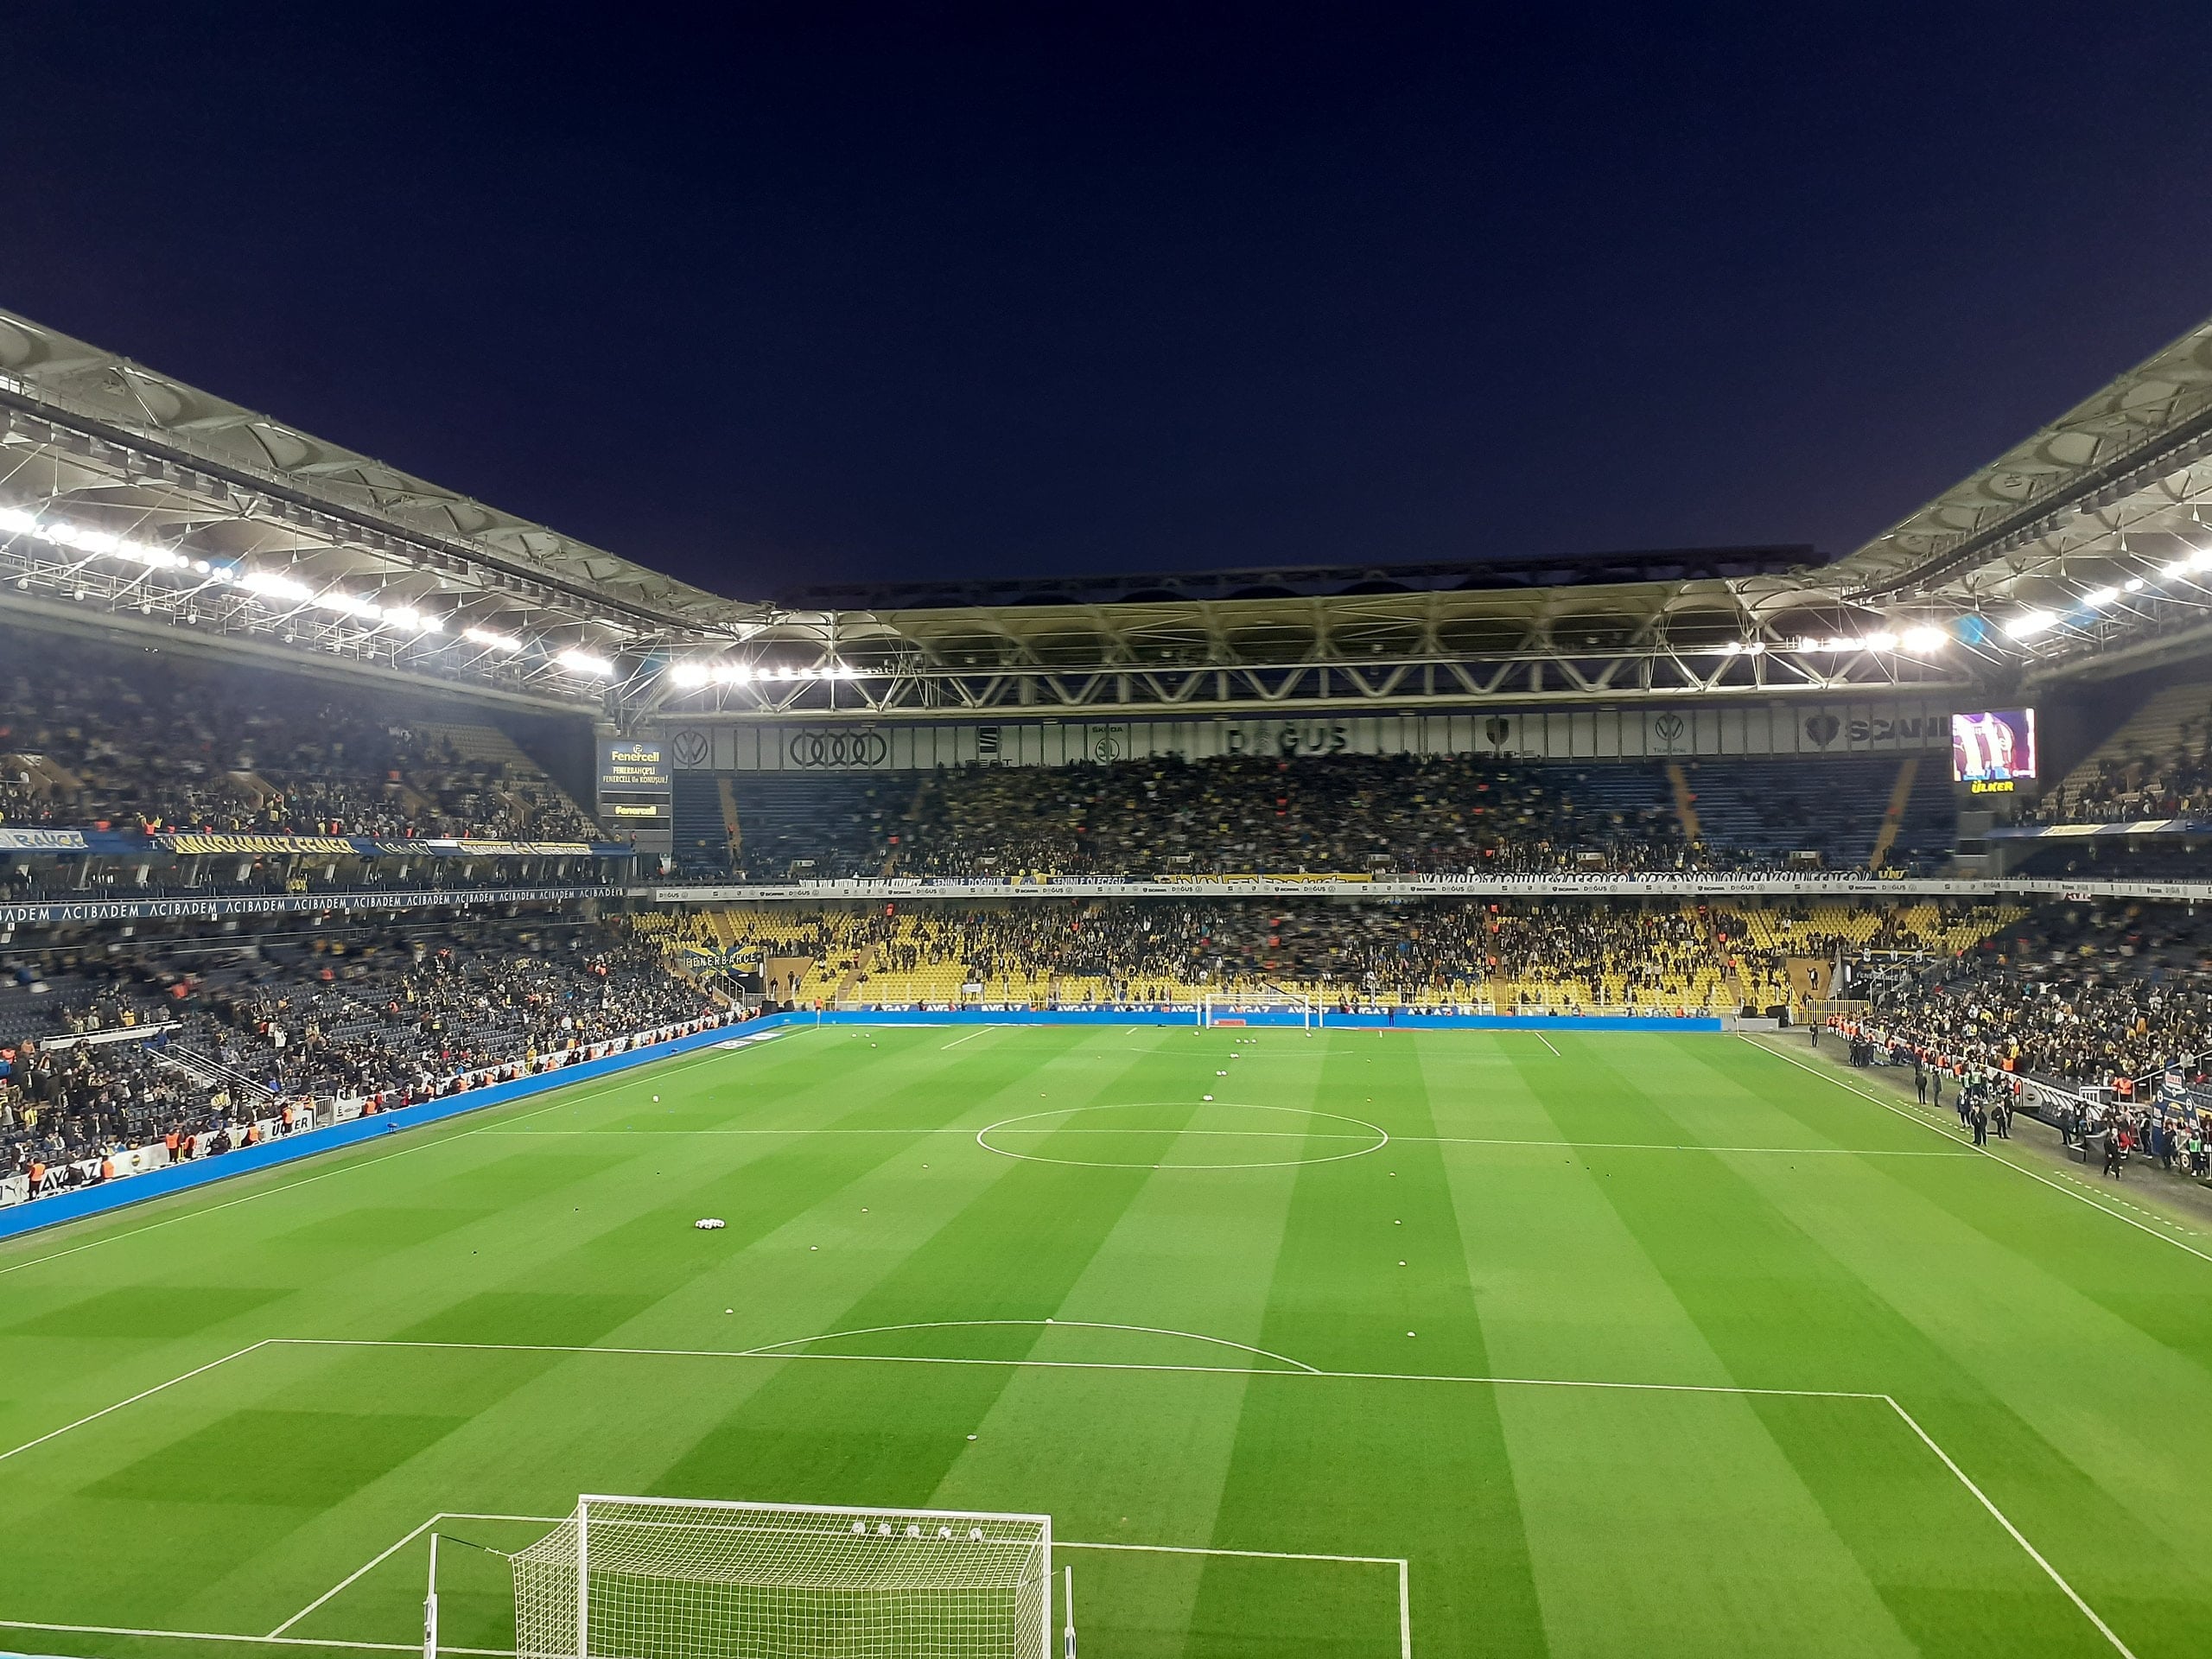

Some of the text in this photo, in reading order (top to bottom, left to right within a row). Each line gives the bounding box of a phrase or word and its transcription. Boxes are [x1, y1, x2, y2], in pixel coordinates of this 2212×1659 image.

[1844, 716, 1948, 741] SCANI
[612, 751, 660, 762] Fenercell
[1971, 780, 2014, 793] ÜLKER
[406, 894, 450, 906] ACIBADEM
[454, 893, 495, 904] ACIBADEM
[499, 891, 536, 902] ACIBADEM
[539, 889, 575, 900] ACIBADEM
[226, 899, 285, 913] ACIBADEM
[294, 898, 346, 911] ACIBADEM
[353, 896, 401, 907] ACIBADEM
[62, 905, 139, 919] ACIBADEM
[149, 901, 217, 917] ACIBADEM
[271, 1116, 308, 1137] ÜLER
